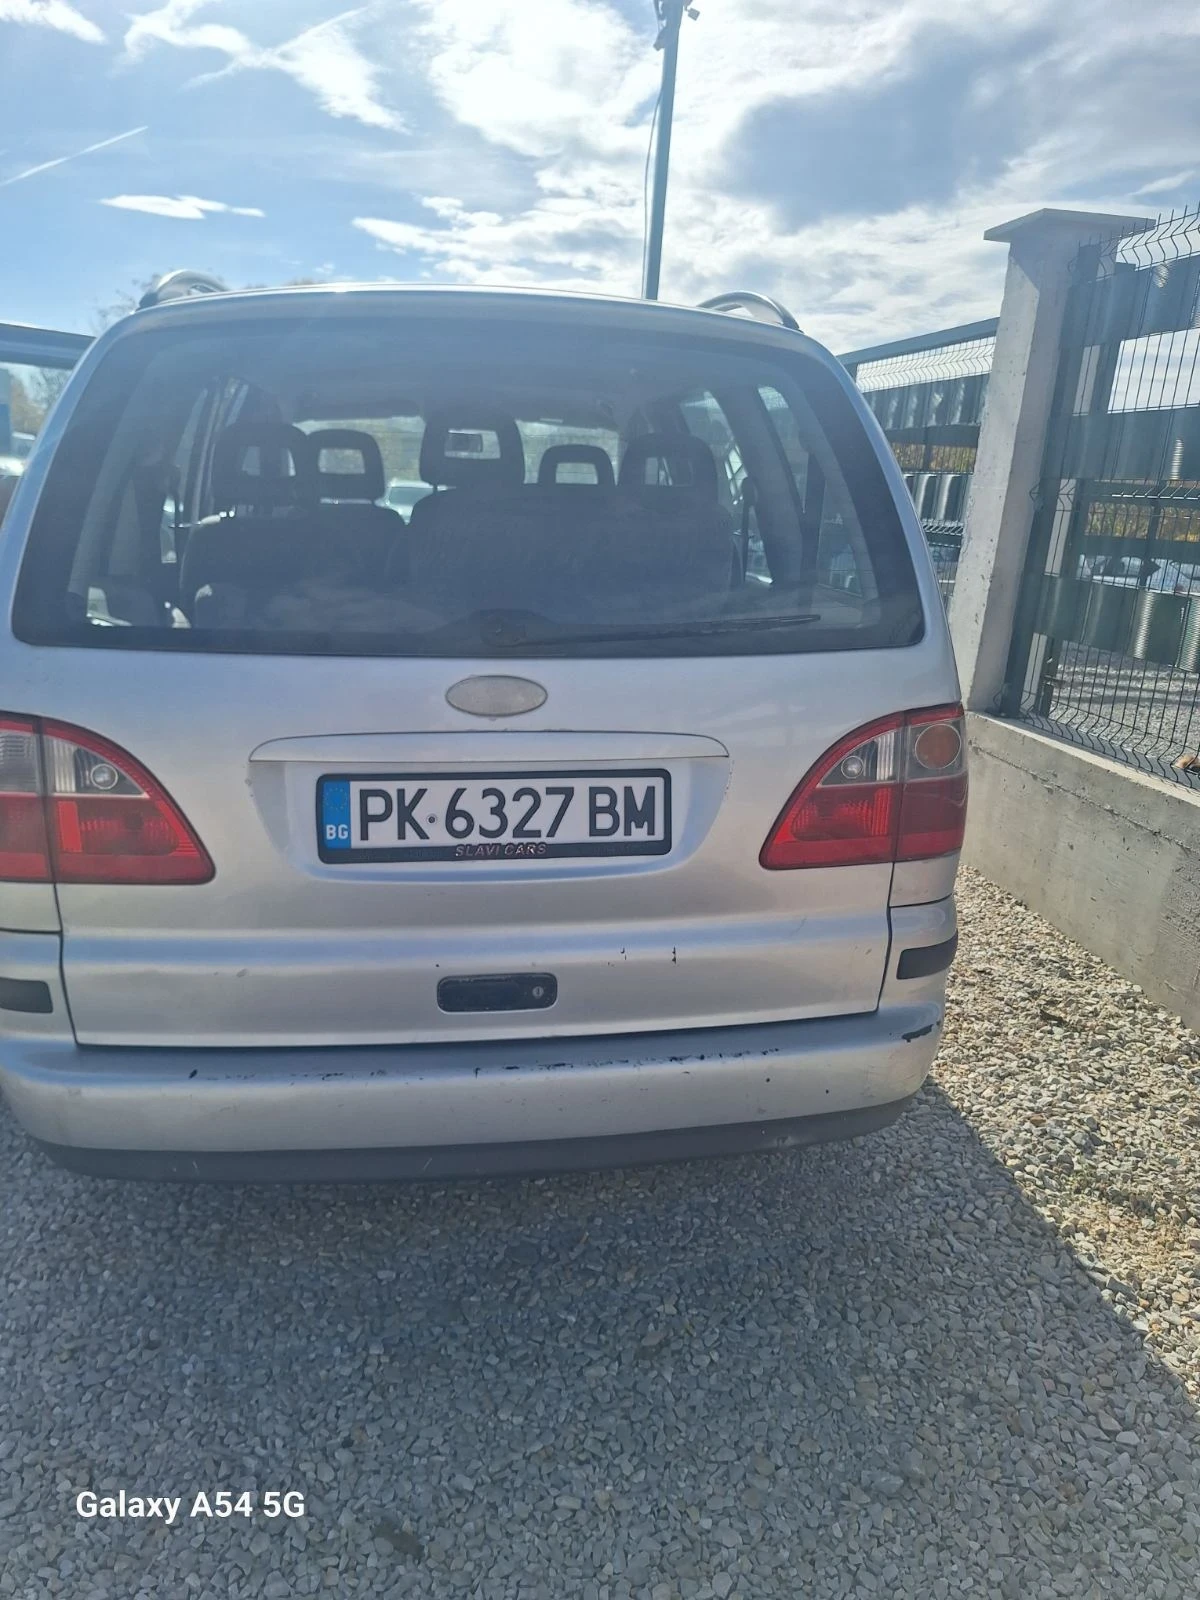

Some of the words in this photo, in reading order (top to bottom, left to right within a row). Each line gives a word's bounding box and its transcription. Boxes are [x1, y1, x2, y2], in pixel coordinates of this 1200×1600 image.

[359, 788, 430, 841] PK
[445, 787, 575, 838] 6327
[588, 785, 656, 837] BM
[326, 825, 349, 840] BG
[455, 844, 500, 857] SLAVI
[504, 842, 547, 855] CARS
